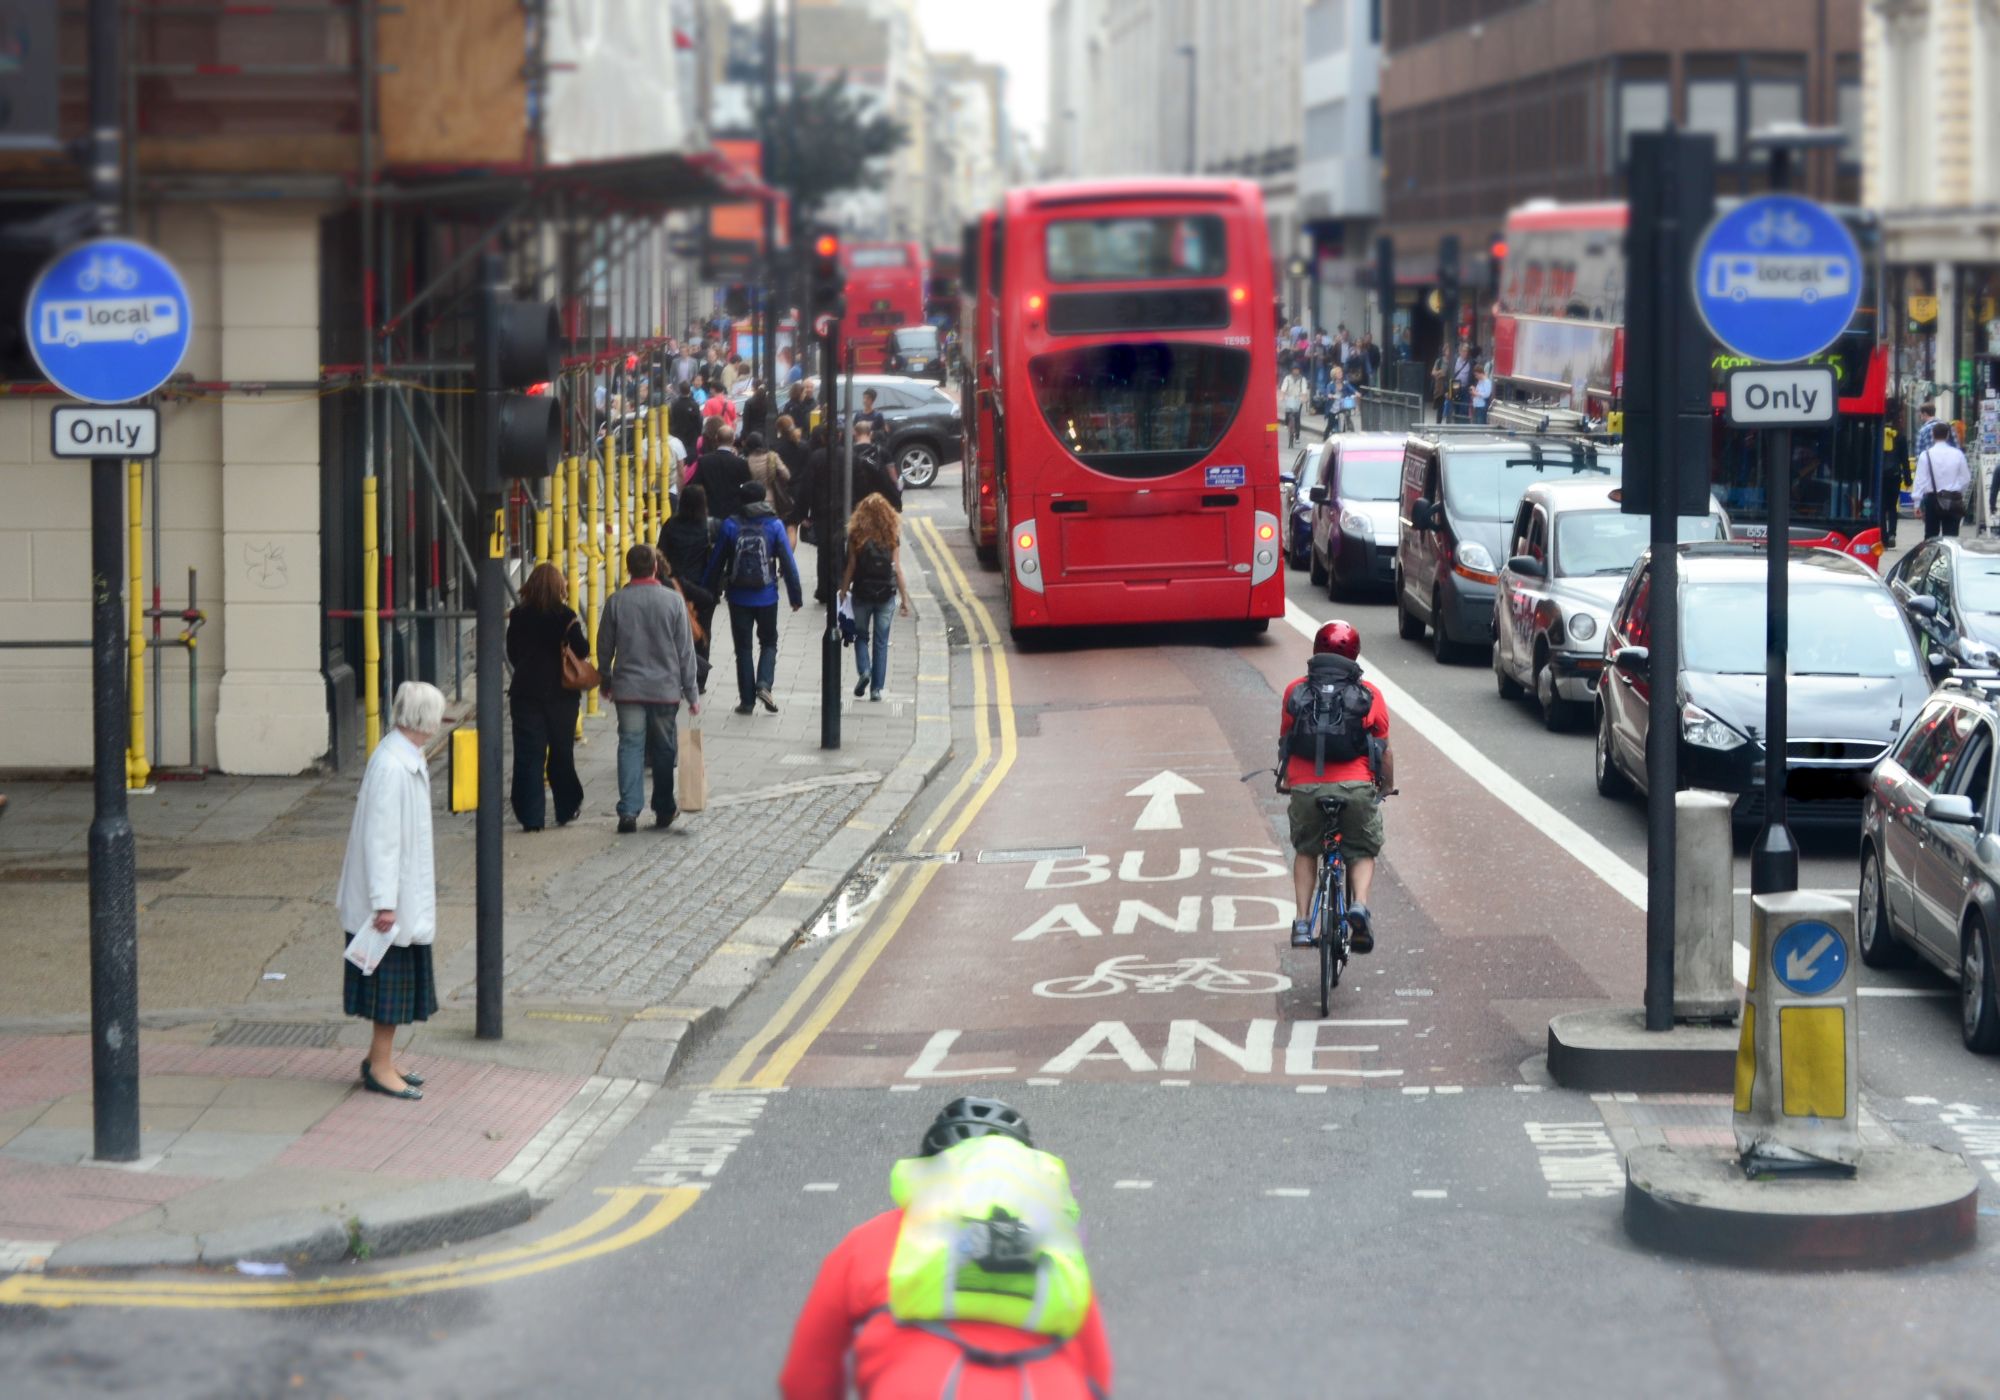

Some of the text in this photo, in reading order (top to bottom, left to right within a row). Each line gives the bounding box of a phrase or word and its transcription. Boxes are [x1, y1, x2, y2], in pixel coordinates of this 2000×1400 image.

[1758, 261, 1822, 282] local
[88, 303, 151, 325] local
[1745, 383, 1819, 414] Only
[70, 419, 141, 448] Only
[1024, 847, 1290, 890] BUS
[1011, 895, 1298, 941] AND
[904, 1019, 1409, 1078] LANE
